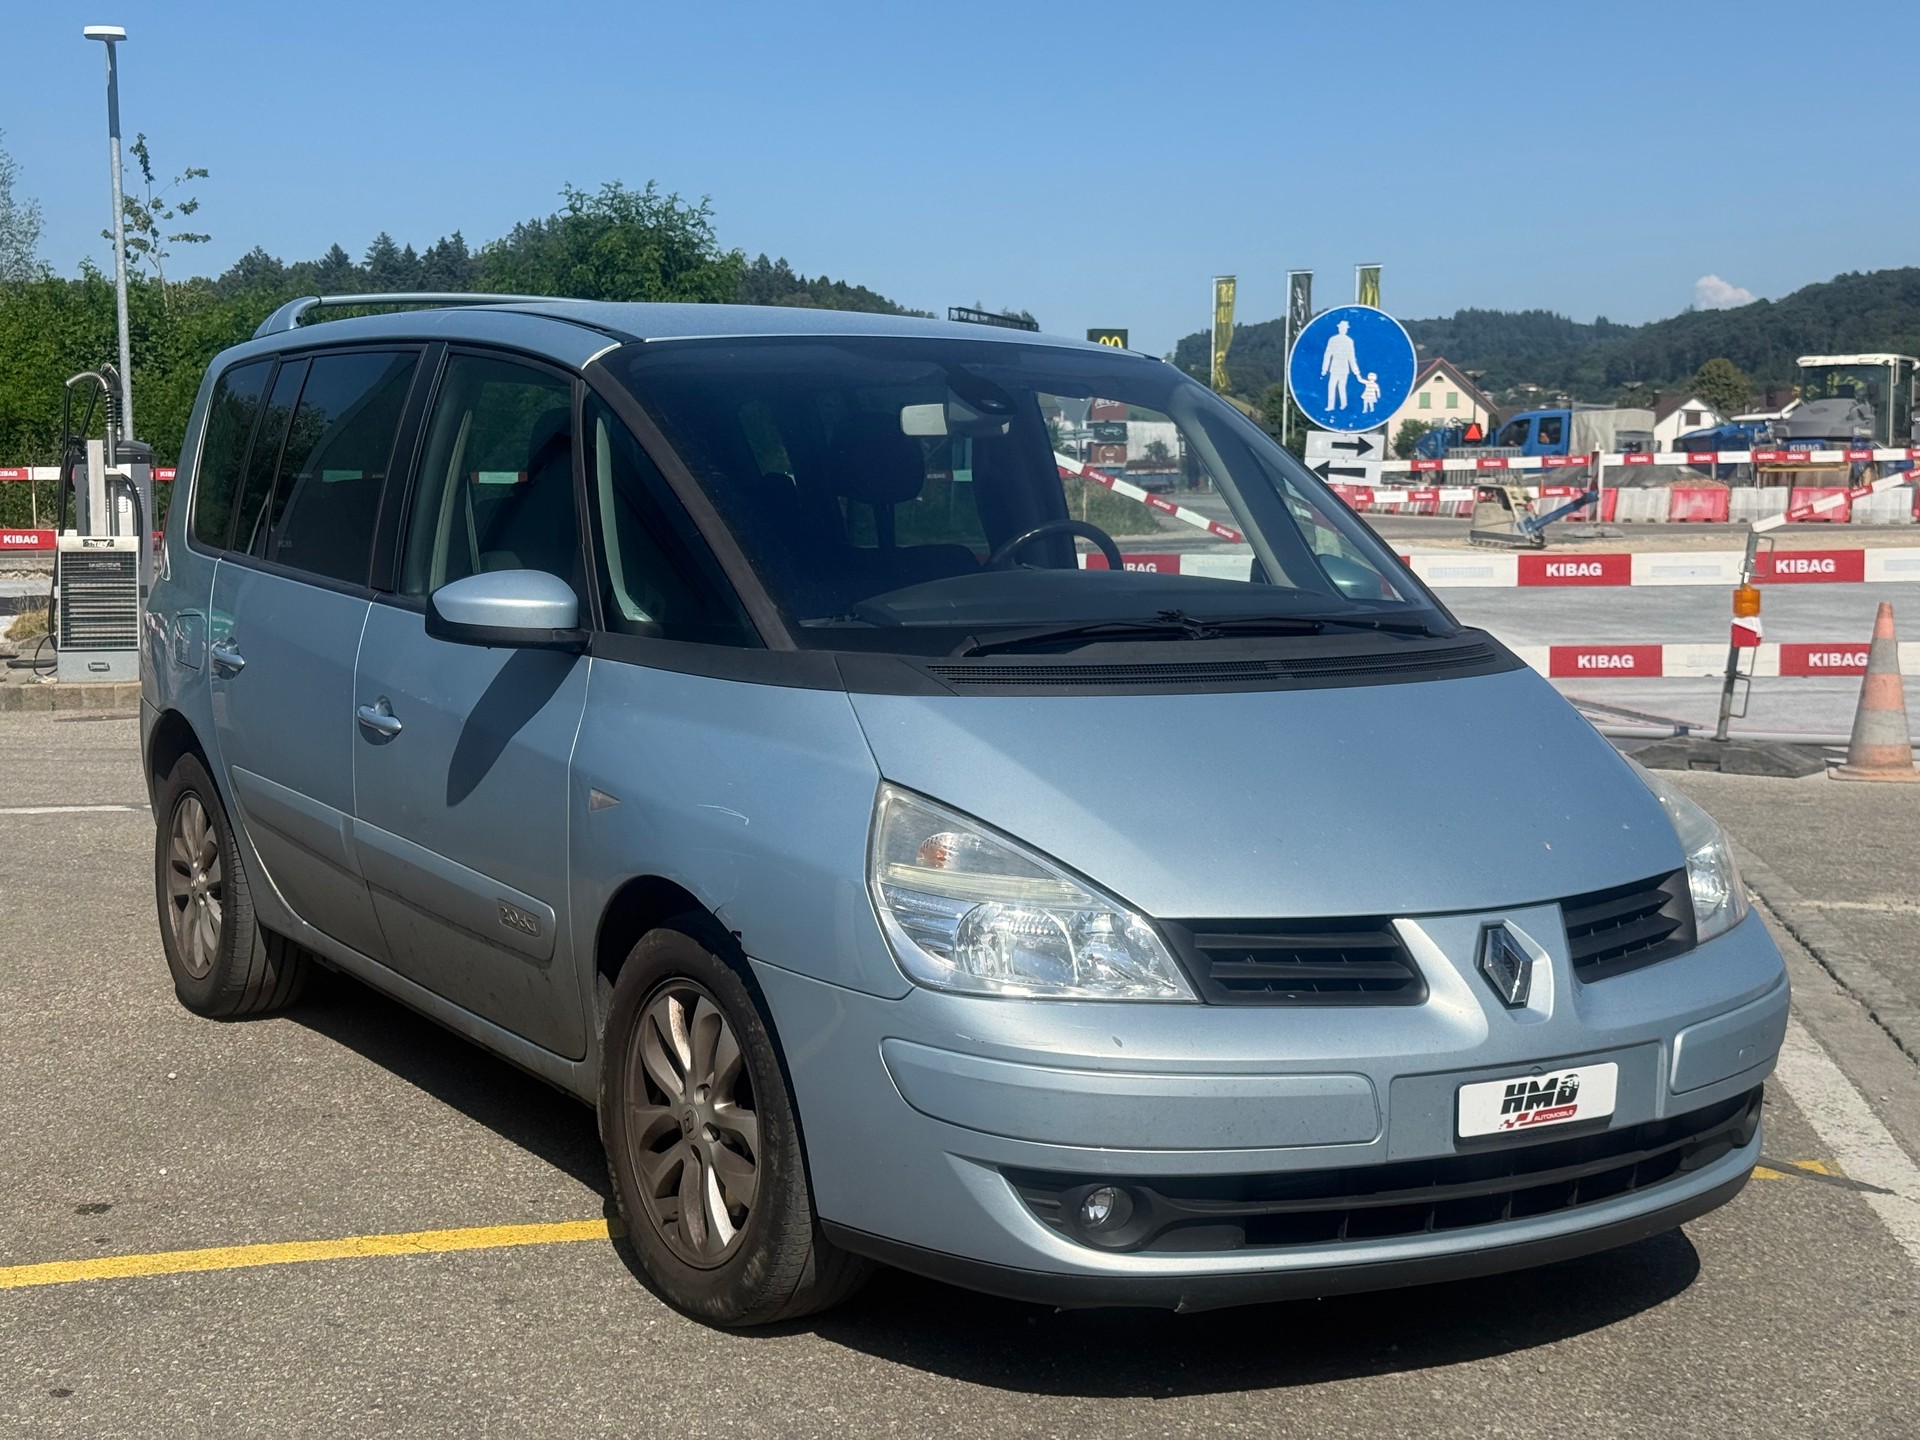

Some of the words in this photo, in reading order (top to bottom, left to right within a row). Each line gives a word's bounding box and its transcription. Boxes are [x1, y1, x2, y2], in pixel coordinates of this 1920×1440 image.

[3, 534, 39, 544] KIBAG
[1123, 562, 1157, 573] BAG
[1546, 562, 1603, 577] KIBAG
[1775, 558, 1836, 574] KIBAG
[1577, 654, 1635, 669] KIBAG
[1808, 652, 1868, 667] KIBAG
